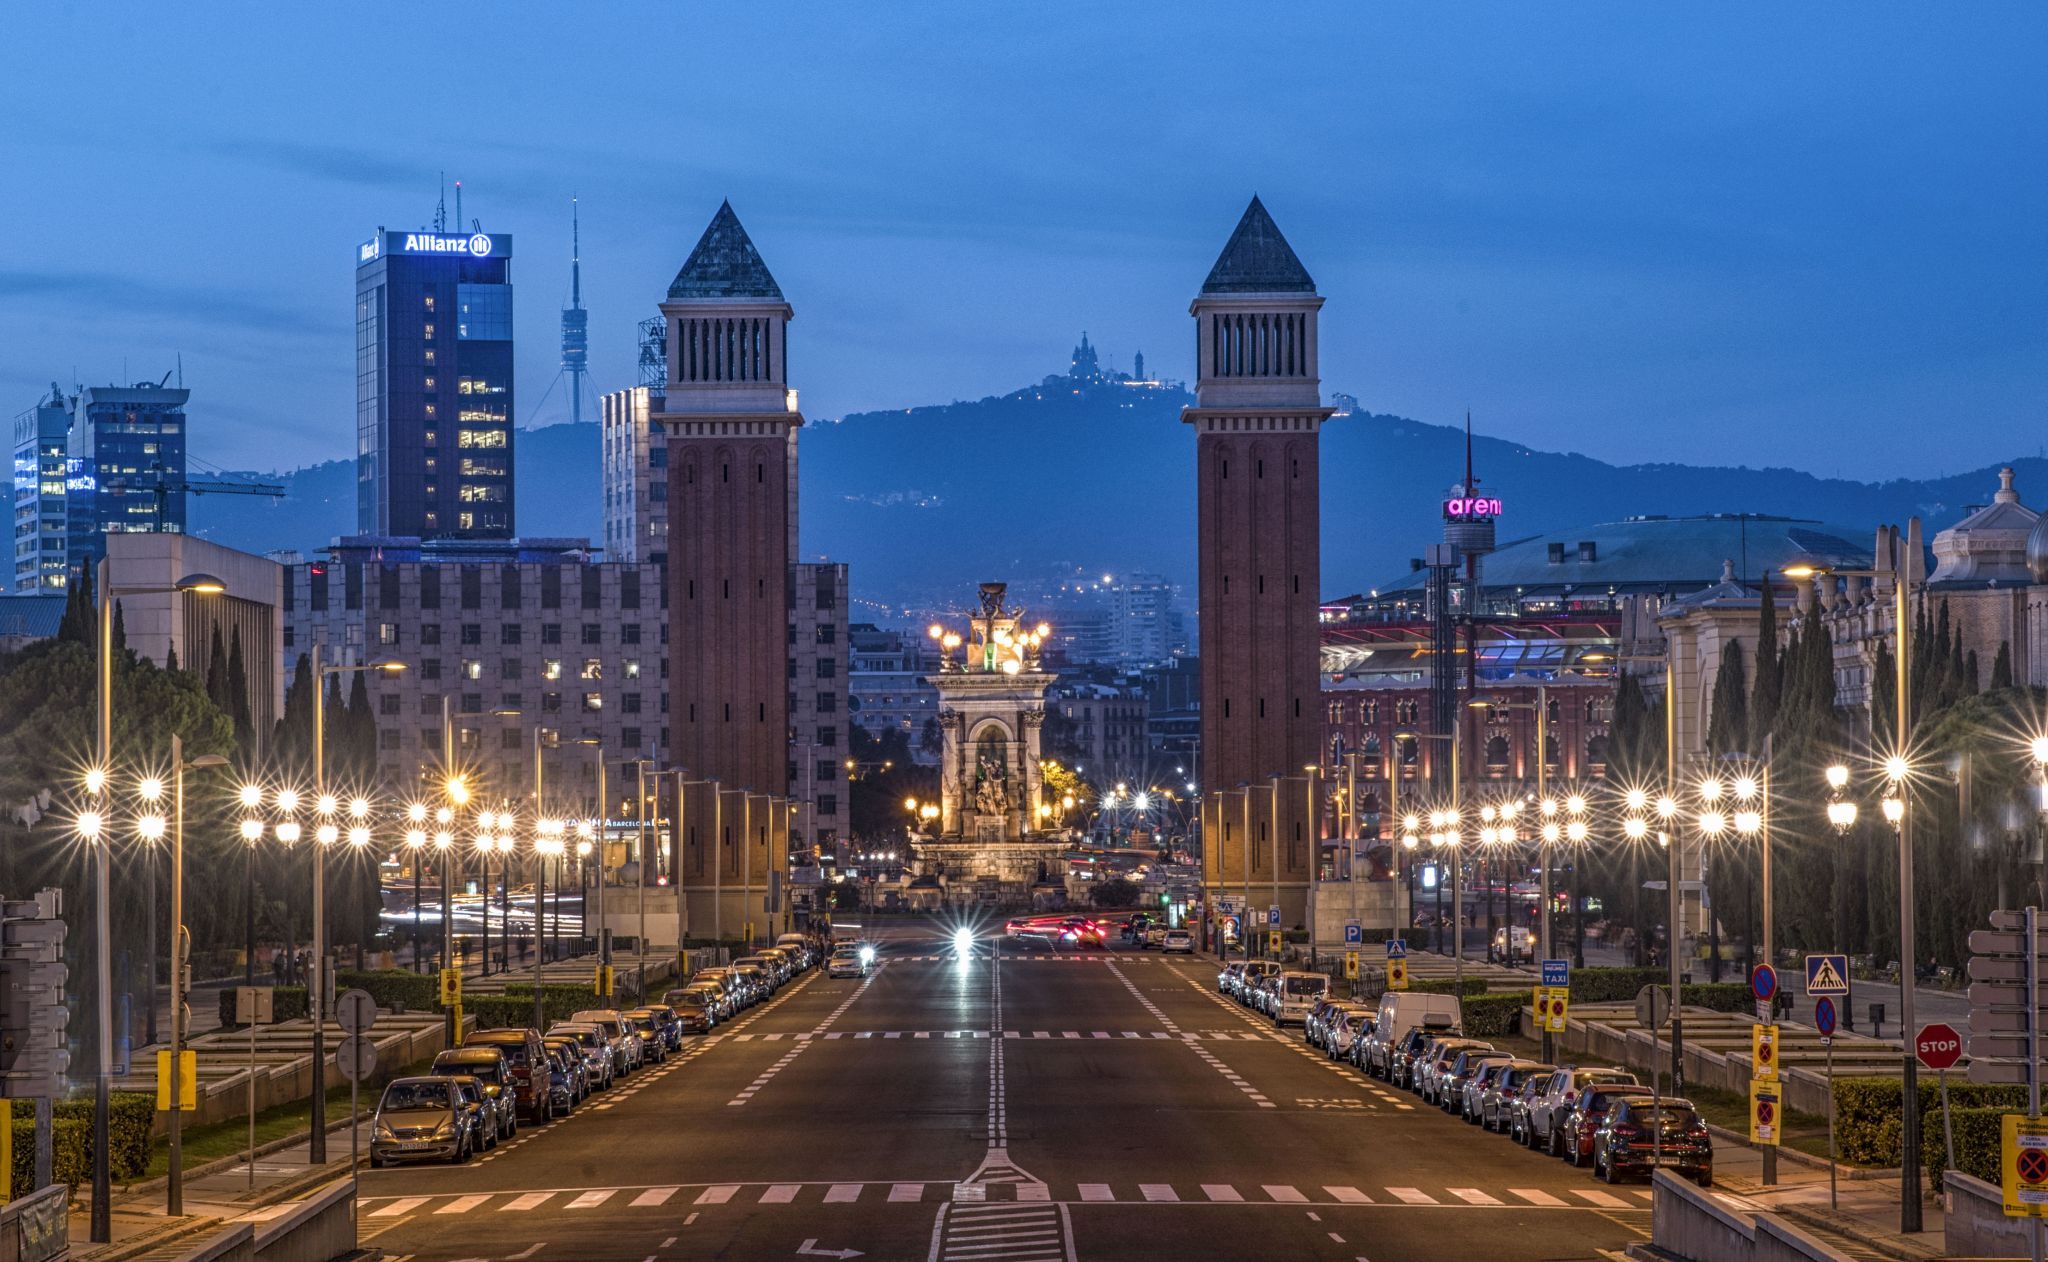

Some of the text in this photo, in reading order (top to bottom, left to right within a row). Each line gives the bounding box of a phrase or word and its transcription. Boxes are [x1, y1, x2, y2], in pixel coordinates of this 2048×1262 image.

[404, 234, 467, 252] Allianz
[1448, 499, 1502, 515] aren
[1271, 911, 1278, 922] P
[1347, 927, 1358, 941] P
[1545, 975, 1566, 983] TAXI
[1920, 1040, 1957, 1053] STOP
